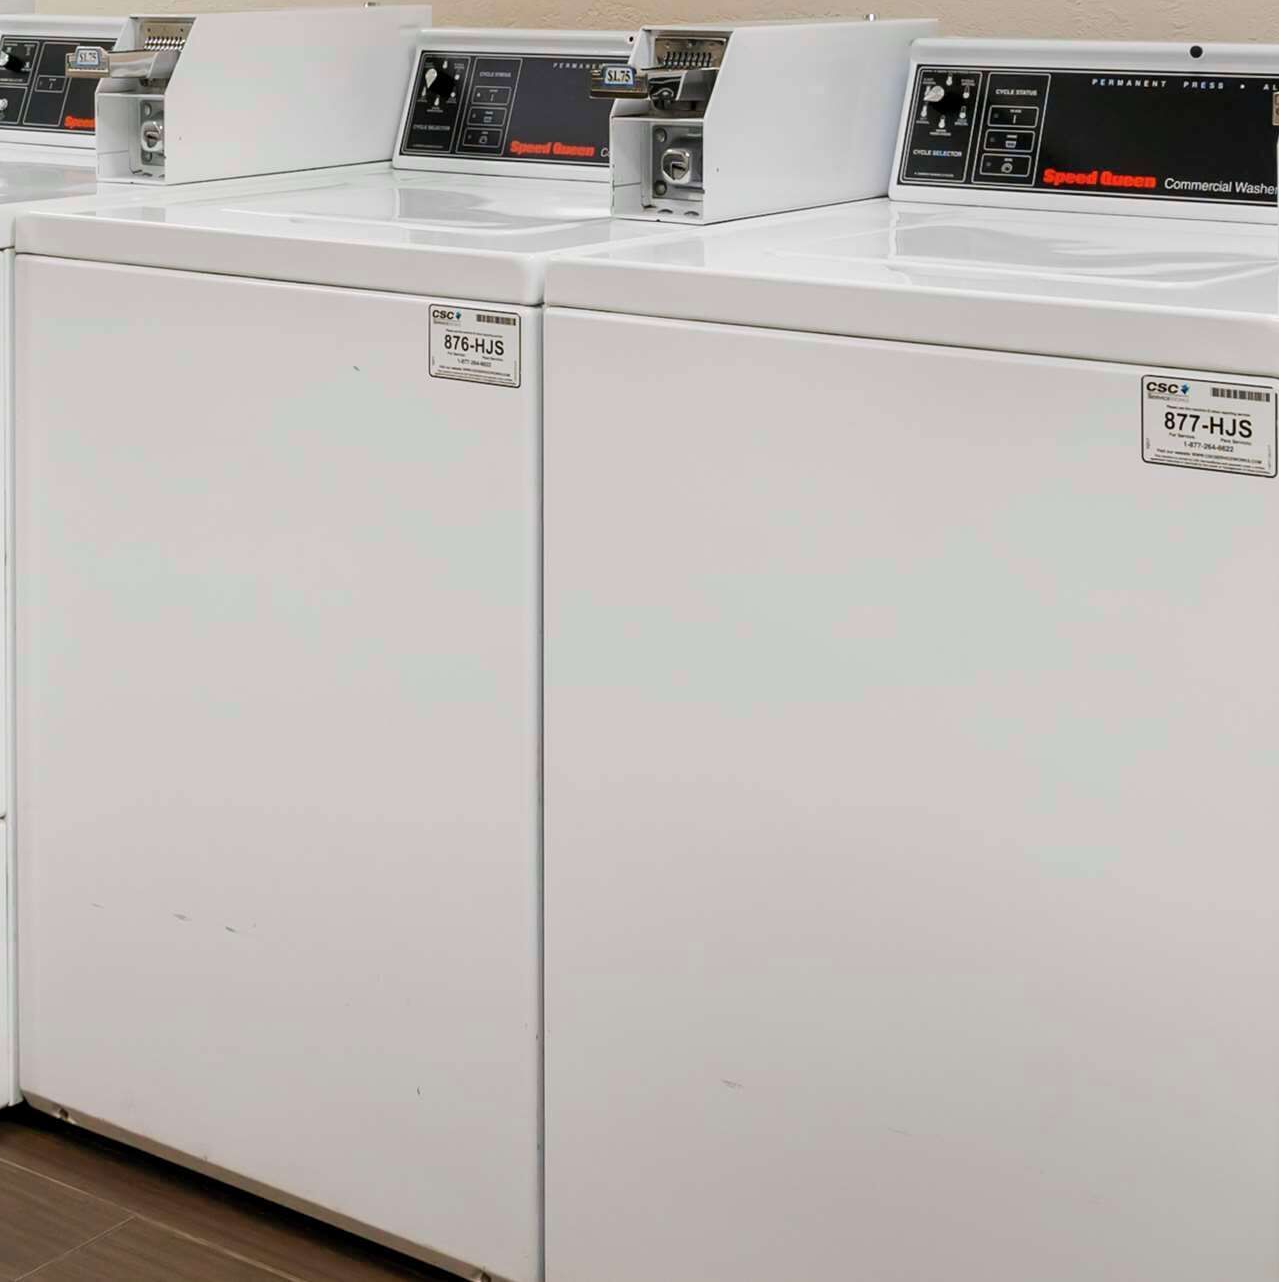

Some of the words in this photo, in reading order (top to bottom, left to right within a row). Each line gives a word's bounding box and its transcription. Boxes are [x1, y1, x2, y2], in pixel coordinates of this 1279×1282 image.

[607, 69, 631, 82] $1.75
[1091, 78, 1167, 88] PERMANENT
[1183, 81, 1224, 90] PRESS
[995, 88, 1014, 96] CYCLE
[1015, 89, 1038, 97] STATUS
[510, 140, 552, 154] Speed
[553, 141, 596, 156] Queen
[1043, 168, 1098, 185] Speed
[1099, 171, 1157, 188] Queen
[1164, 177, 1232, 192] Commercial
[432, 309, 455, 320] CSC
[444, 334, 504, 356] 876-HJS
[1146, 381, 1179, 394] CSC
[1164, 411, 1252, 438] 877-HJS
